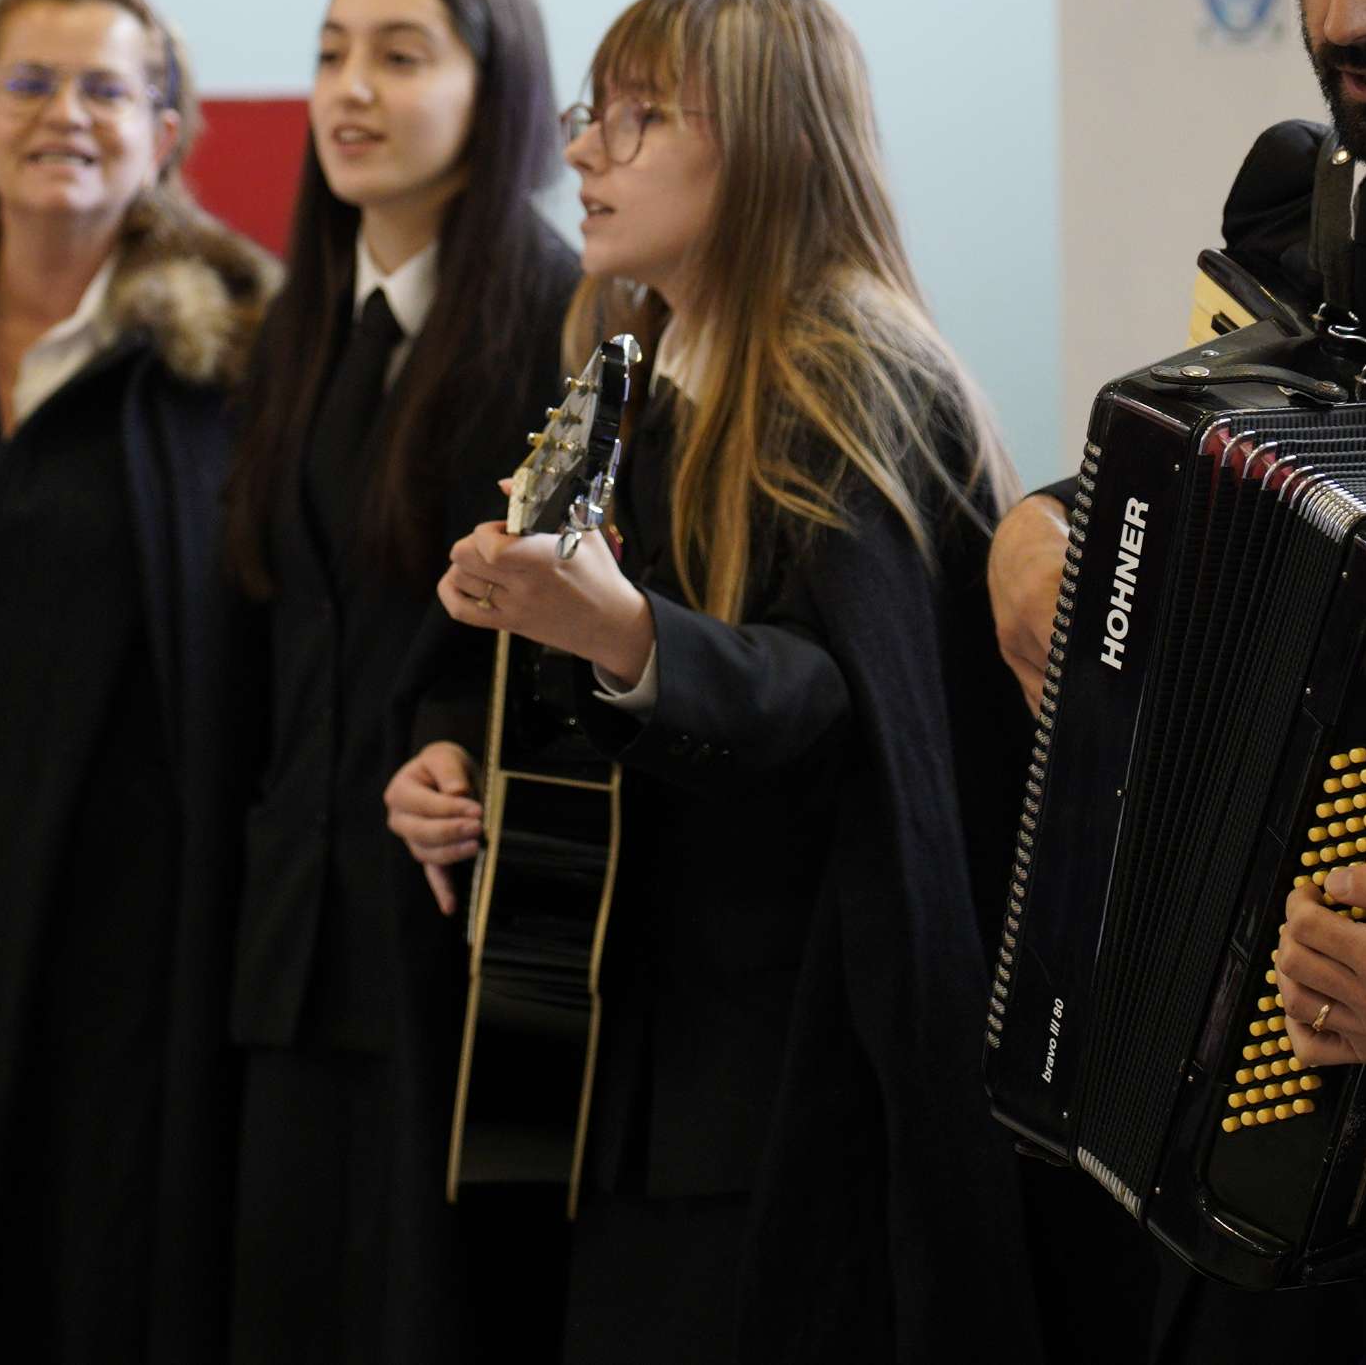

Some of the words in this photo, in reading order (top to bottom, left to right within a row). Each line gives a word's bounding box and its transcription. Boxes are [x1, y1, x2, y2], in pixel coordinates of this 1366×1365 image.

[1100, 496, 1150, 671] HOHNER
[1042, 1038, 1057, 1083] bravo
[1053, 998, 1064, 1018] 80
